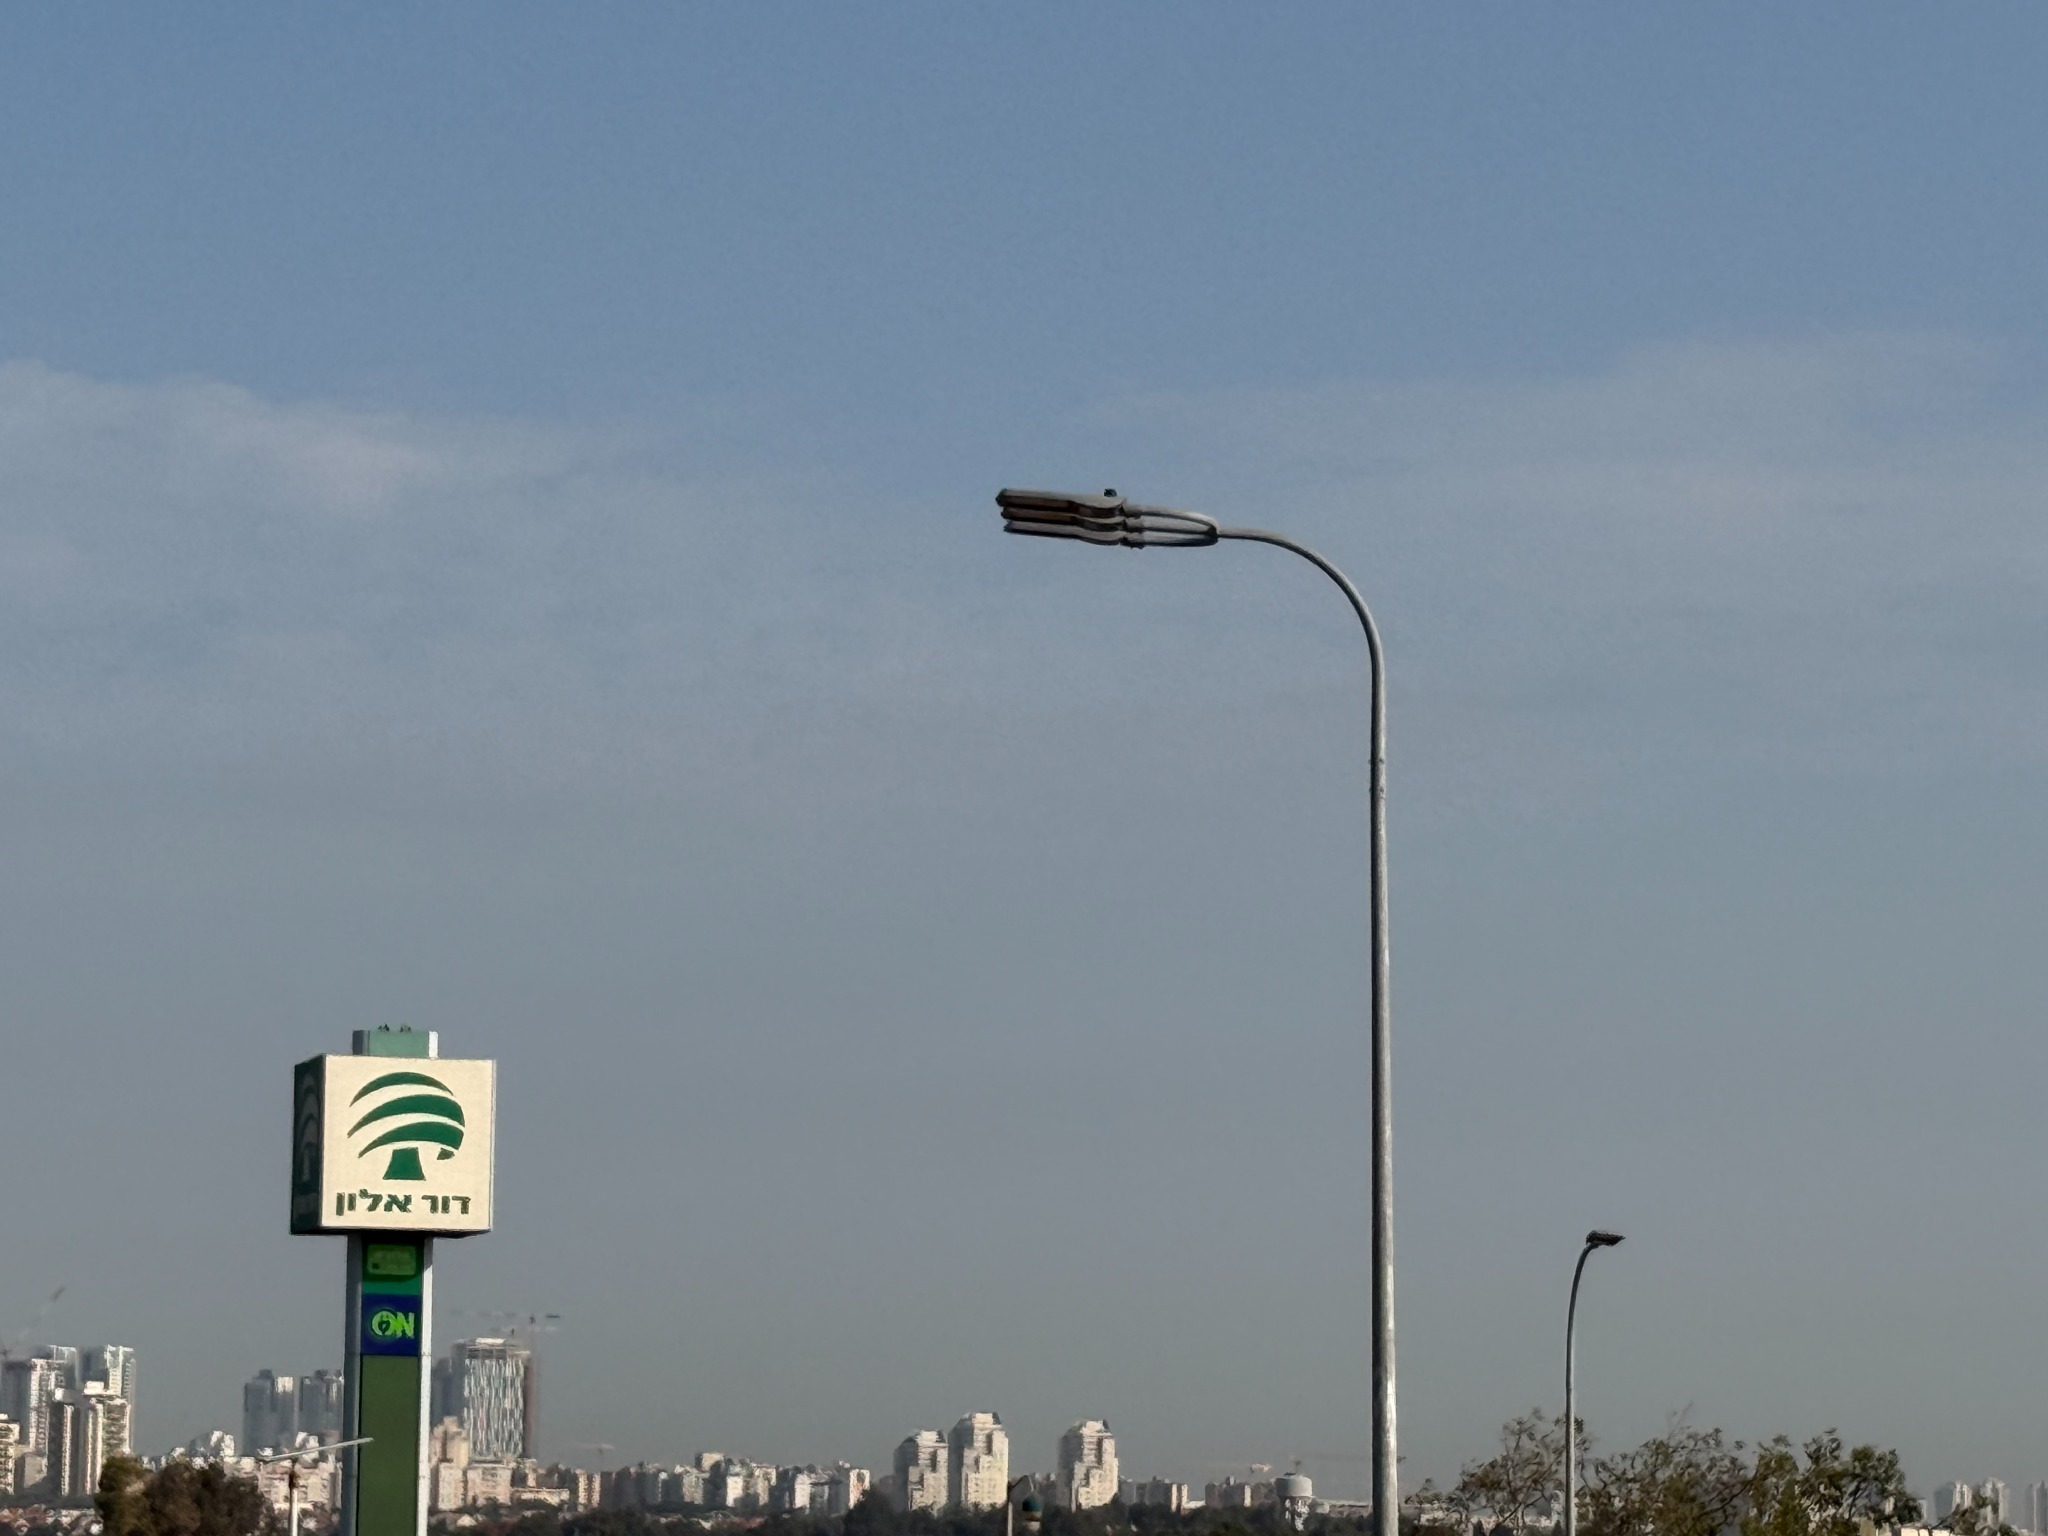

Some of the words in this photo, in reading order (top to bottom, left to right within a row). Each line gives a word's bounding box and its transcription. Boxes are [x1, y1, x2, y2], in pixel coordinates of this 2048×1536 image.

[336, 1189, 412, 1216] אלון
[421, 1195, 471, 1214] דור
[371, 1310, 415, 1339] ON
